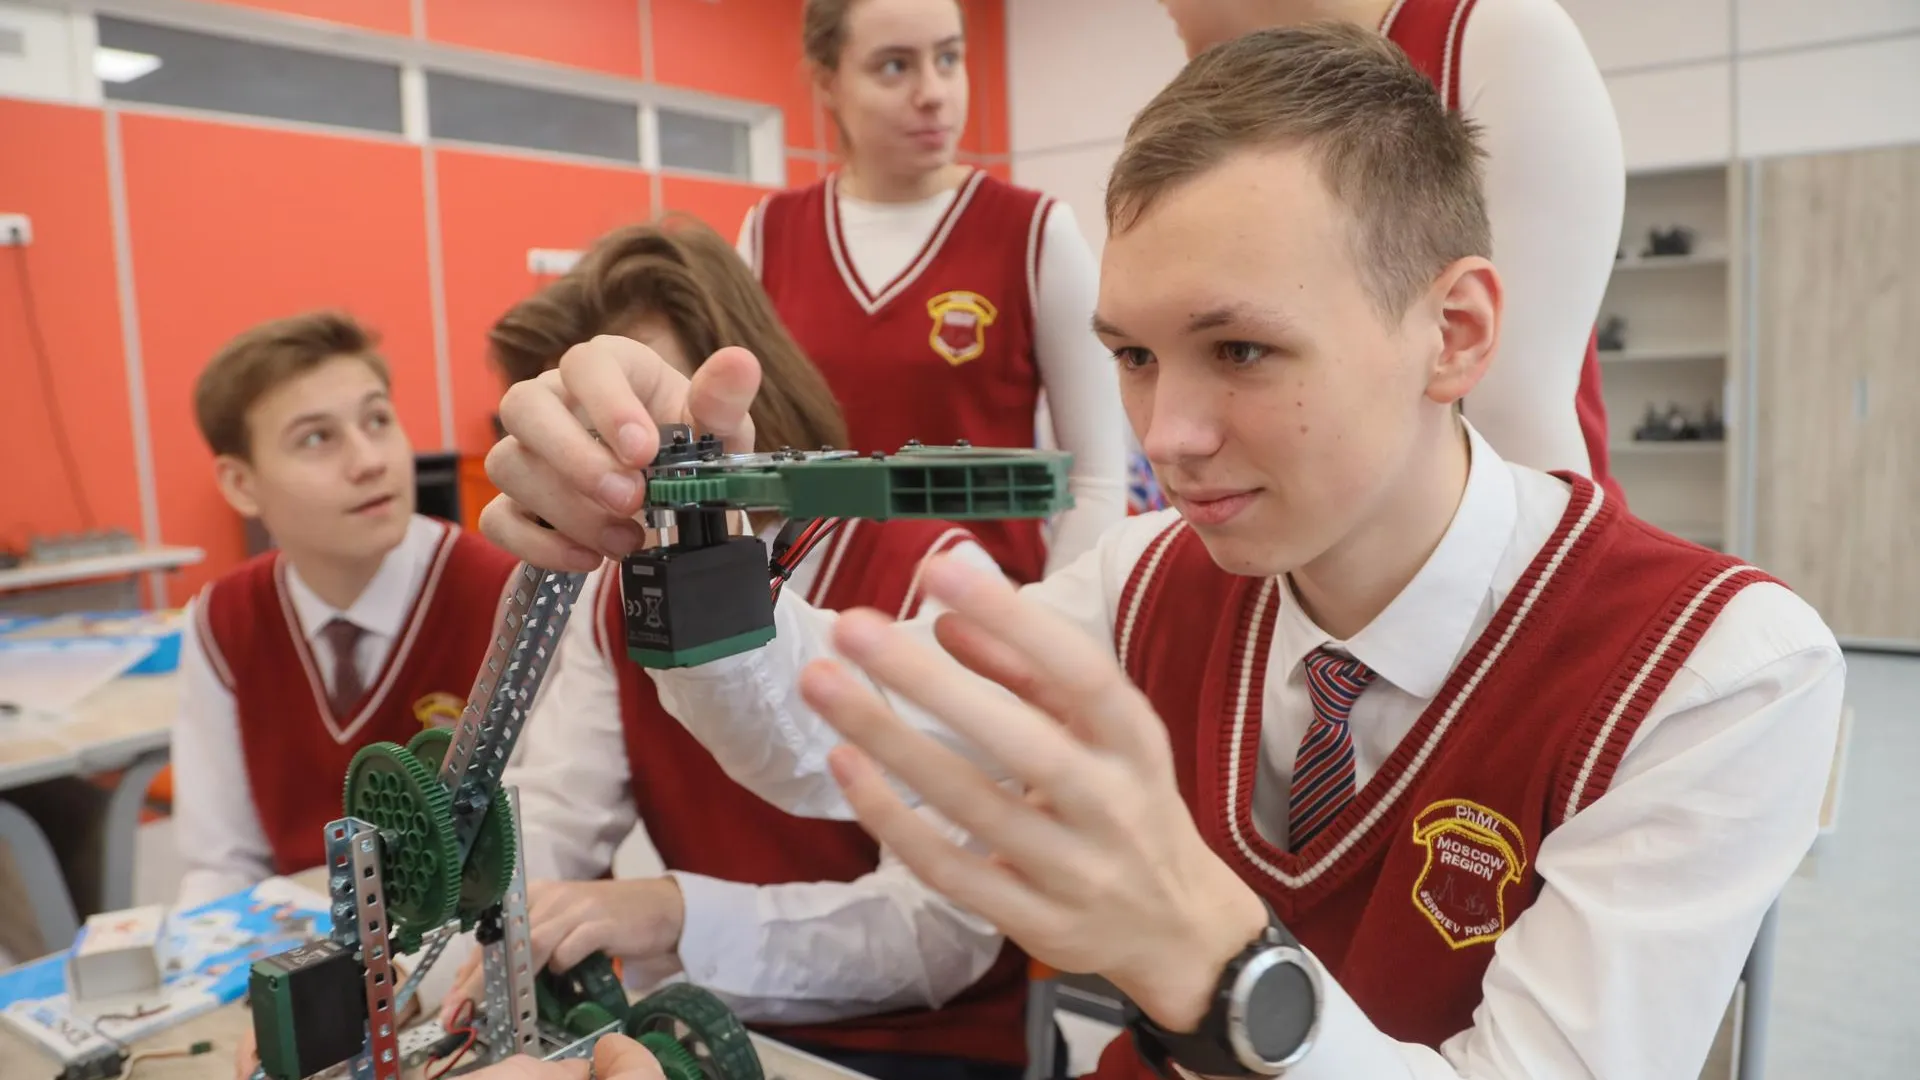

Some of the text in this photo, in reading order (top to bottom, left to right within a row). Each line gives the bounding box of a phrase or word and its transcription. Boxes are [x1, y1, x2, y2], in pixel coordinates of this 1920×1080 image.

[1455, 804, 1502, 835] PhML
[1437, 836, 1505, 871] MOSCOW
[1440, 851, 1494, 881] REGION
[1464, 917, 1500, 936] POSAD
